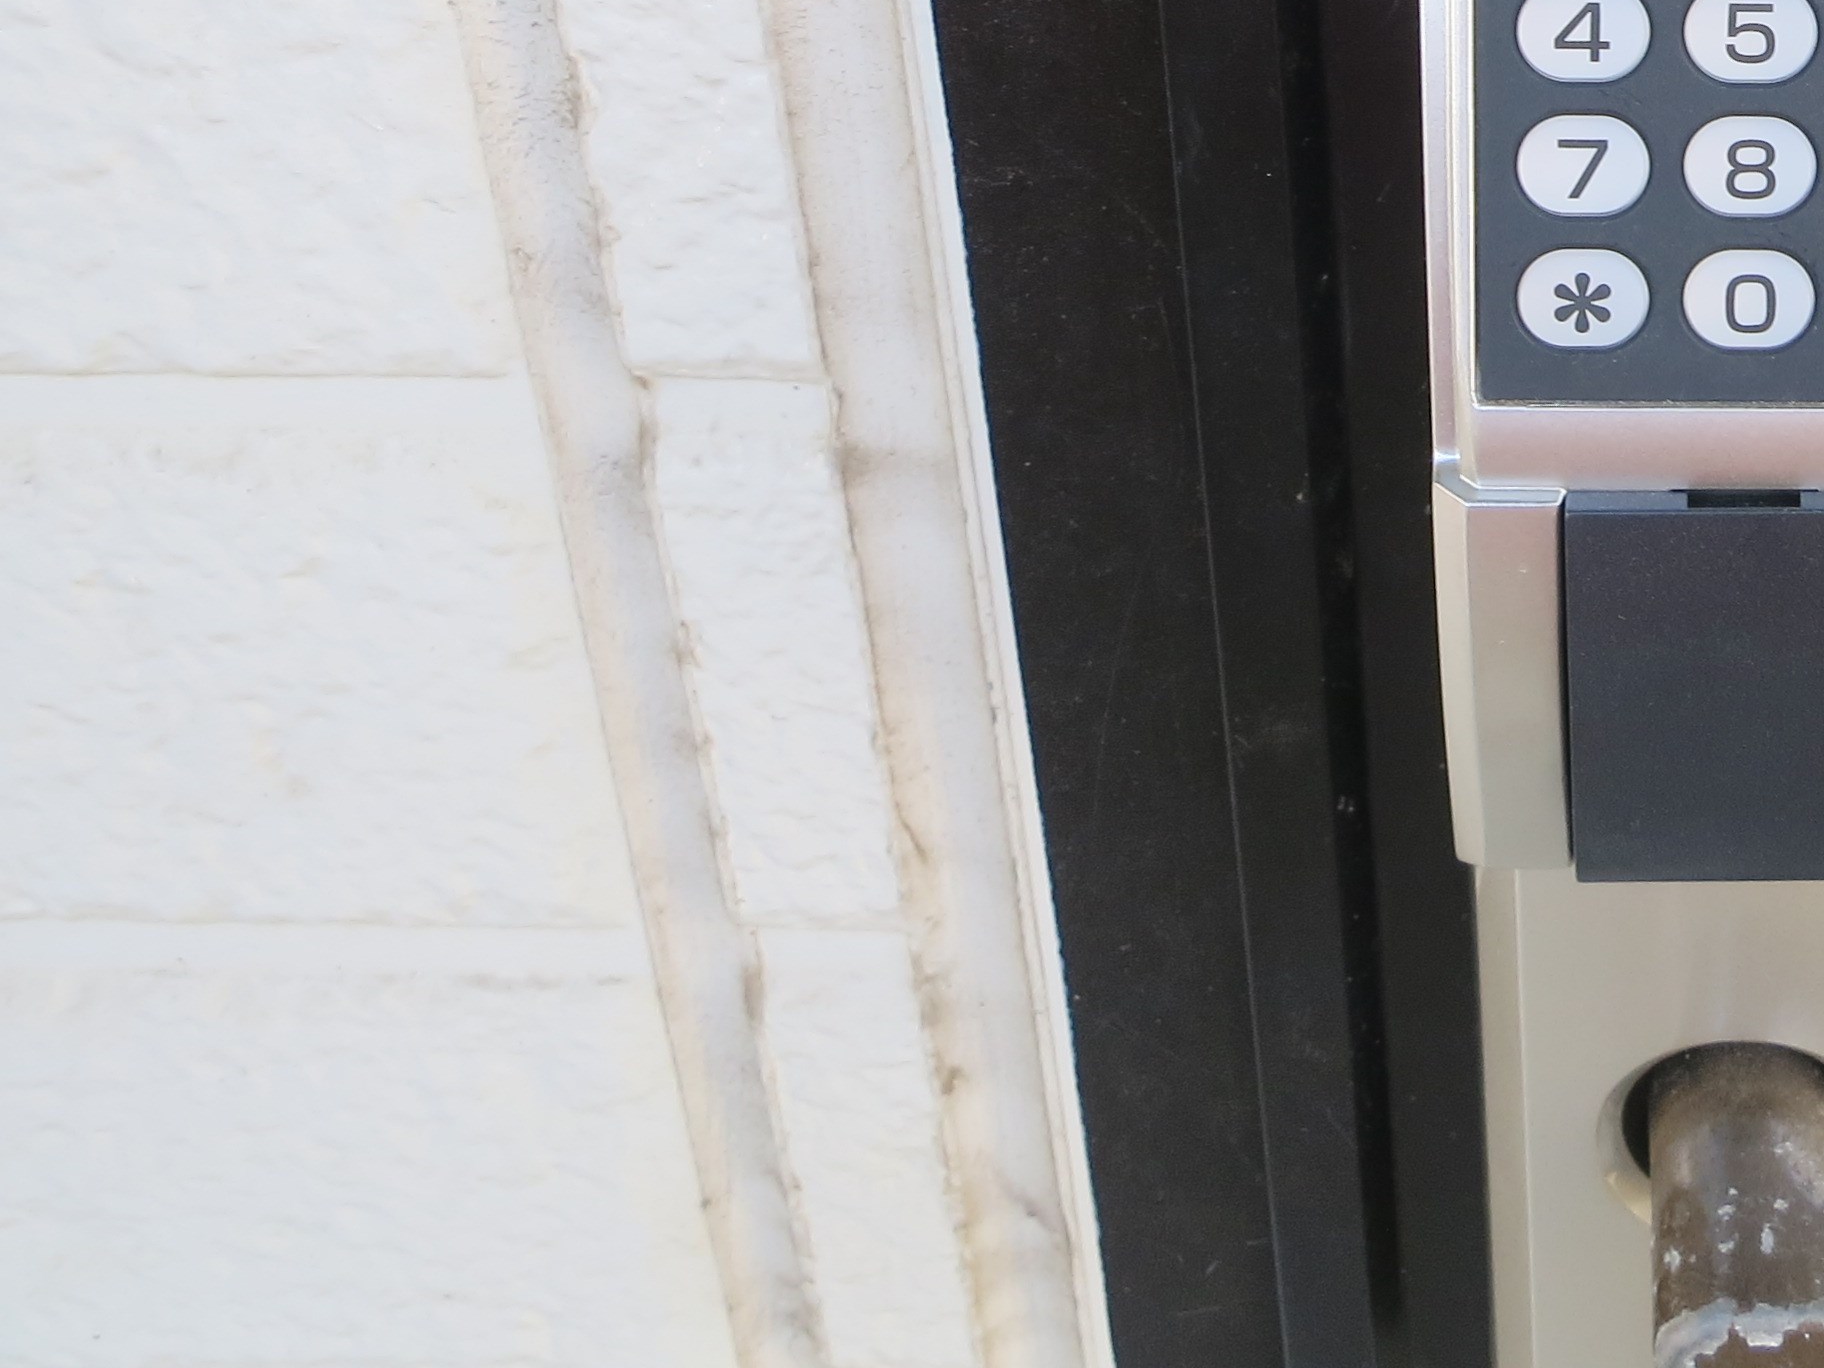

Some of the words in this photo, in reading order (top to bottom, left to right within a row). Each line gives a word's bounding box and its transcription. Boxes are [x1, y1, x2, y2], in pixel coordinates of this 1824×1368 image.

[1554, 2, 1611, 63] 4
[1725, 2, 1776, 64] 5
[1557, 138, 1609, 199] 7
[1725, 139, 1777, 200] 8
[1725, 274, 1777, 334] 0
